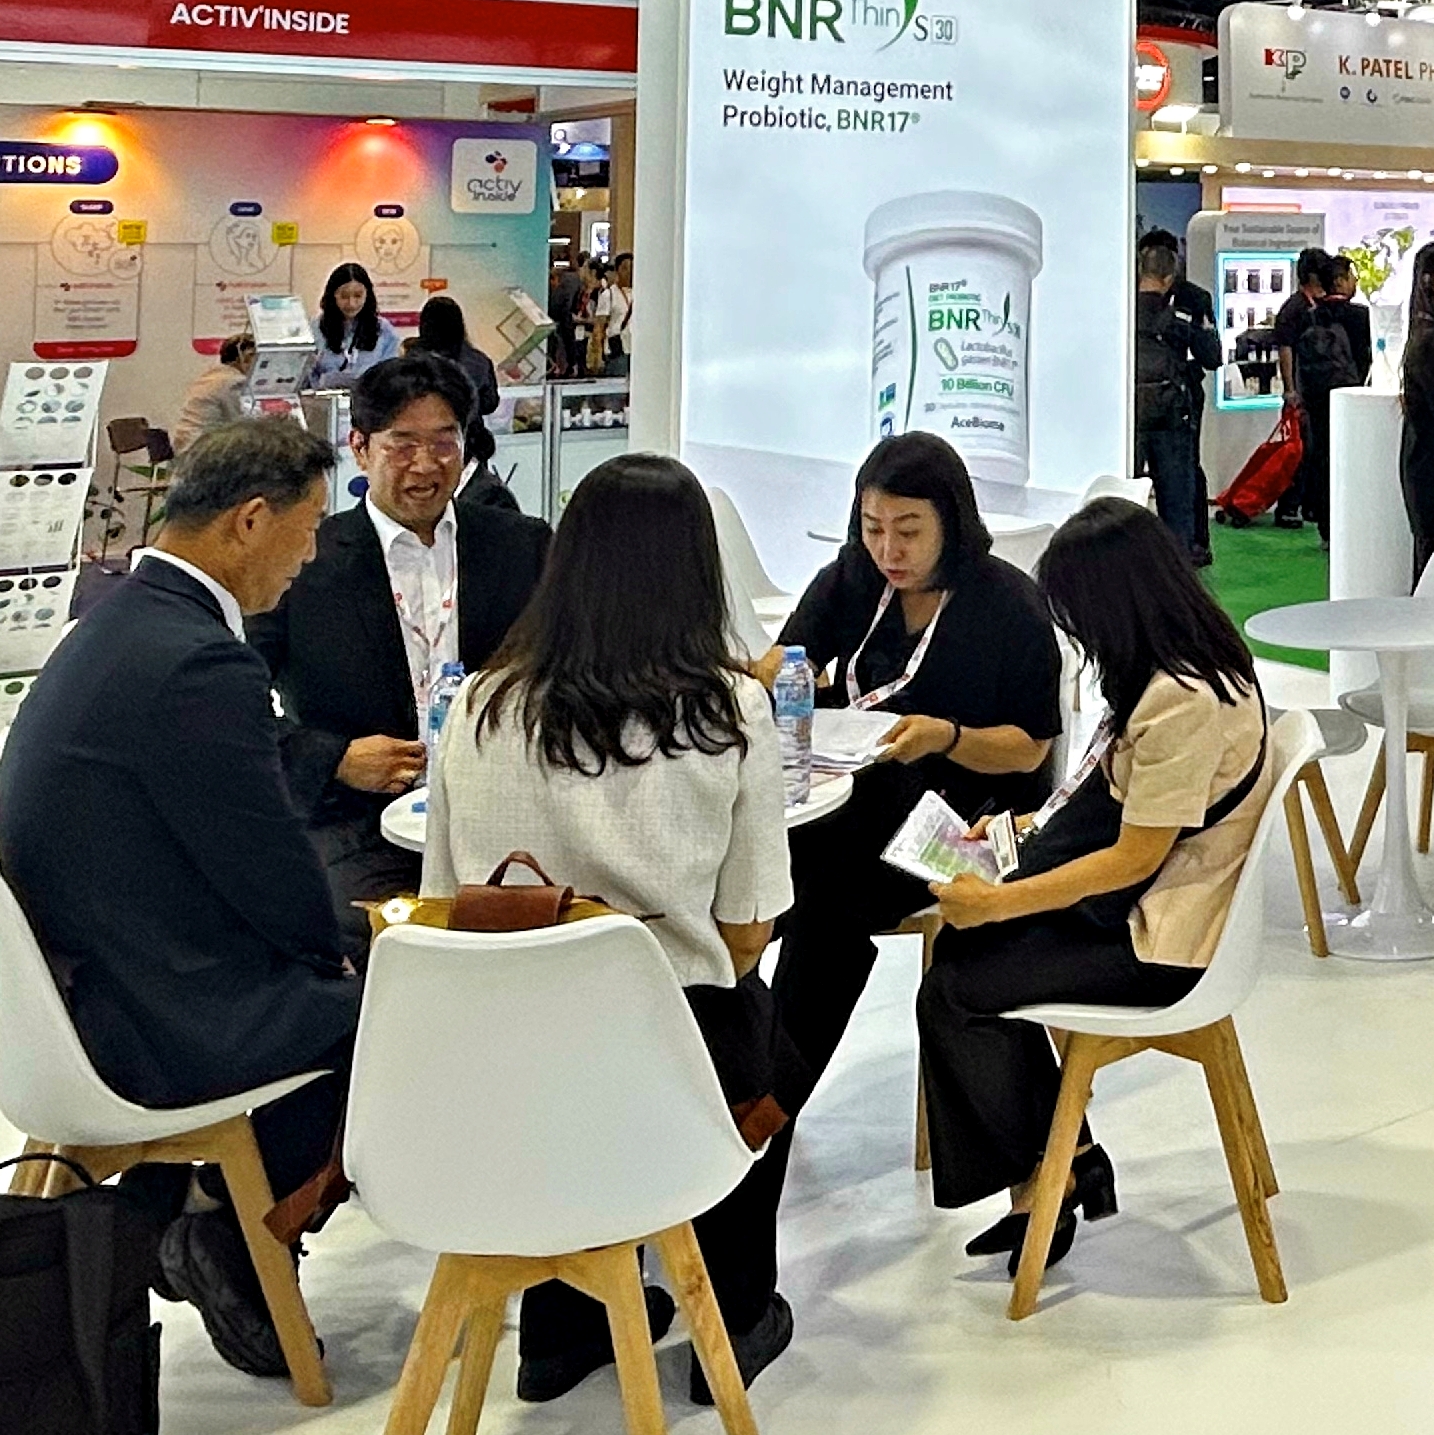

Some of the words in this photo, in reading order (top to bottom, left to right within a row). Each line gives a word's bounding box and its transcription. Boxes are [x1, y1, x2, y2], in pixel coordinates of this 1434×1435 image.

[169, 2, 351, 35] ACTIV'INSIDE
[934, 18, 954, 42] 30
[1338, 54, 1357, 76] K.
[1360, 57, 1414, 81] PATEL
[723, 68, 804, 98] Weight
[810, 72, 954, 102] Management
[723, 105, 832, 132] Probiotic,
[1, 154, 83, 176] TIONS
[928, 308, 982, 332] BNR
